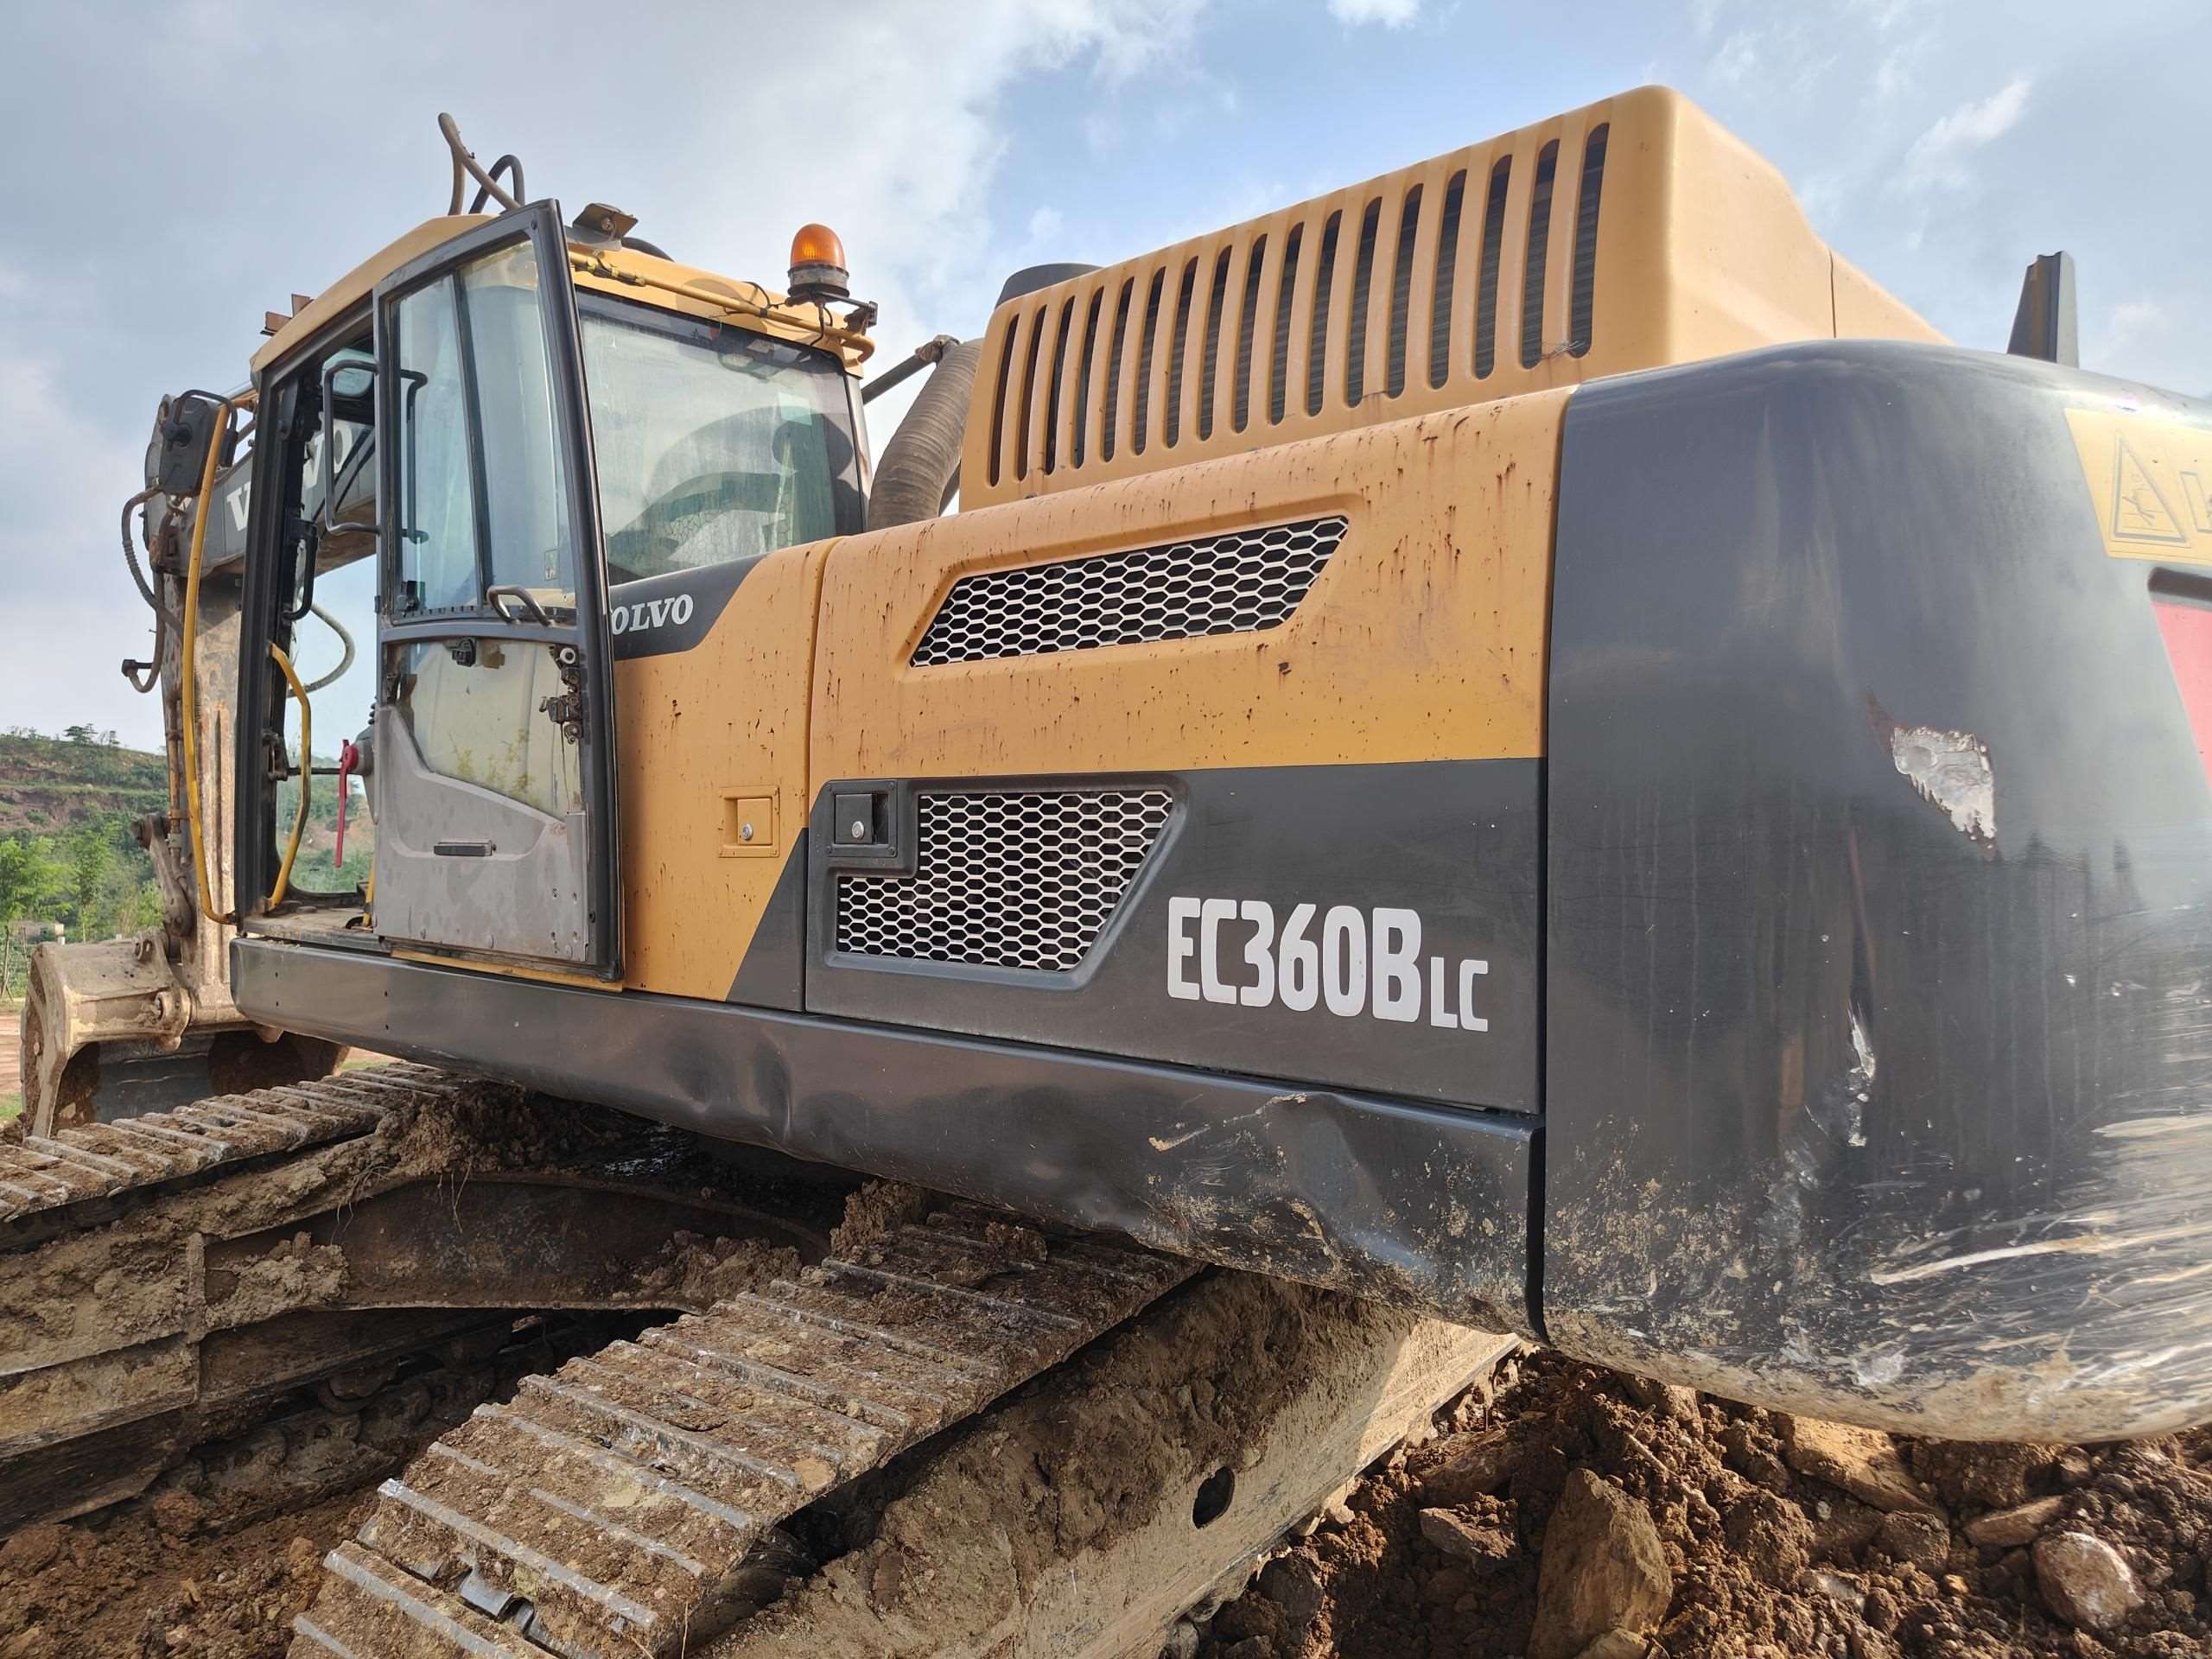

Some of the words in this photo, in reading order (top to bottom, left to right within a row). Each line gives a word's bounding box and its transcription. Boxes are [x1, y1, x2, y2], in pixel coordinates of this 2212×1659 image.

[610, 594, 694, 636] OLVO
[1167, 896, 1421, 1023] EC360B
[1430, 957, 1489, 1032] LC
